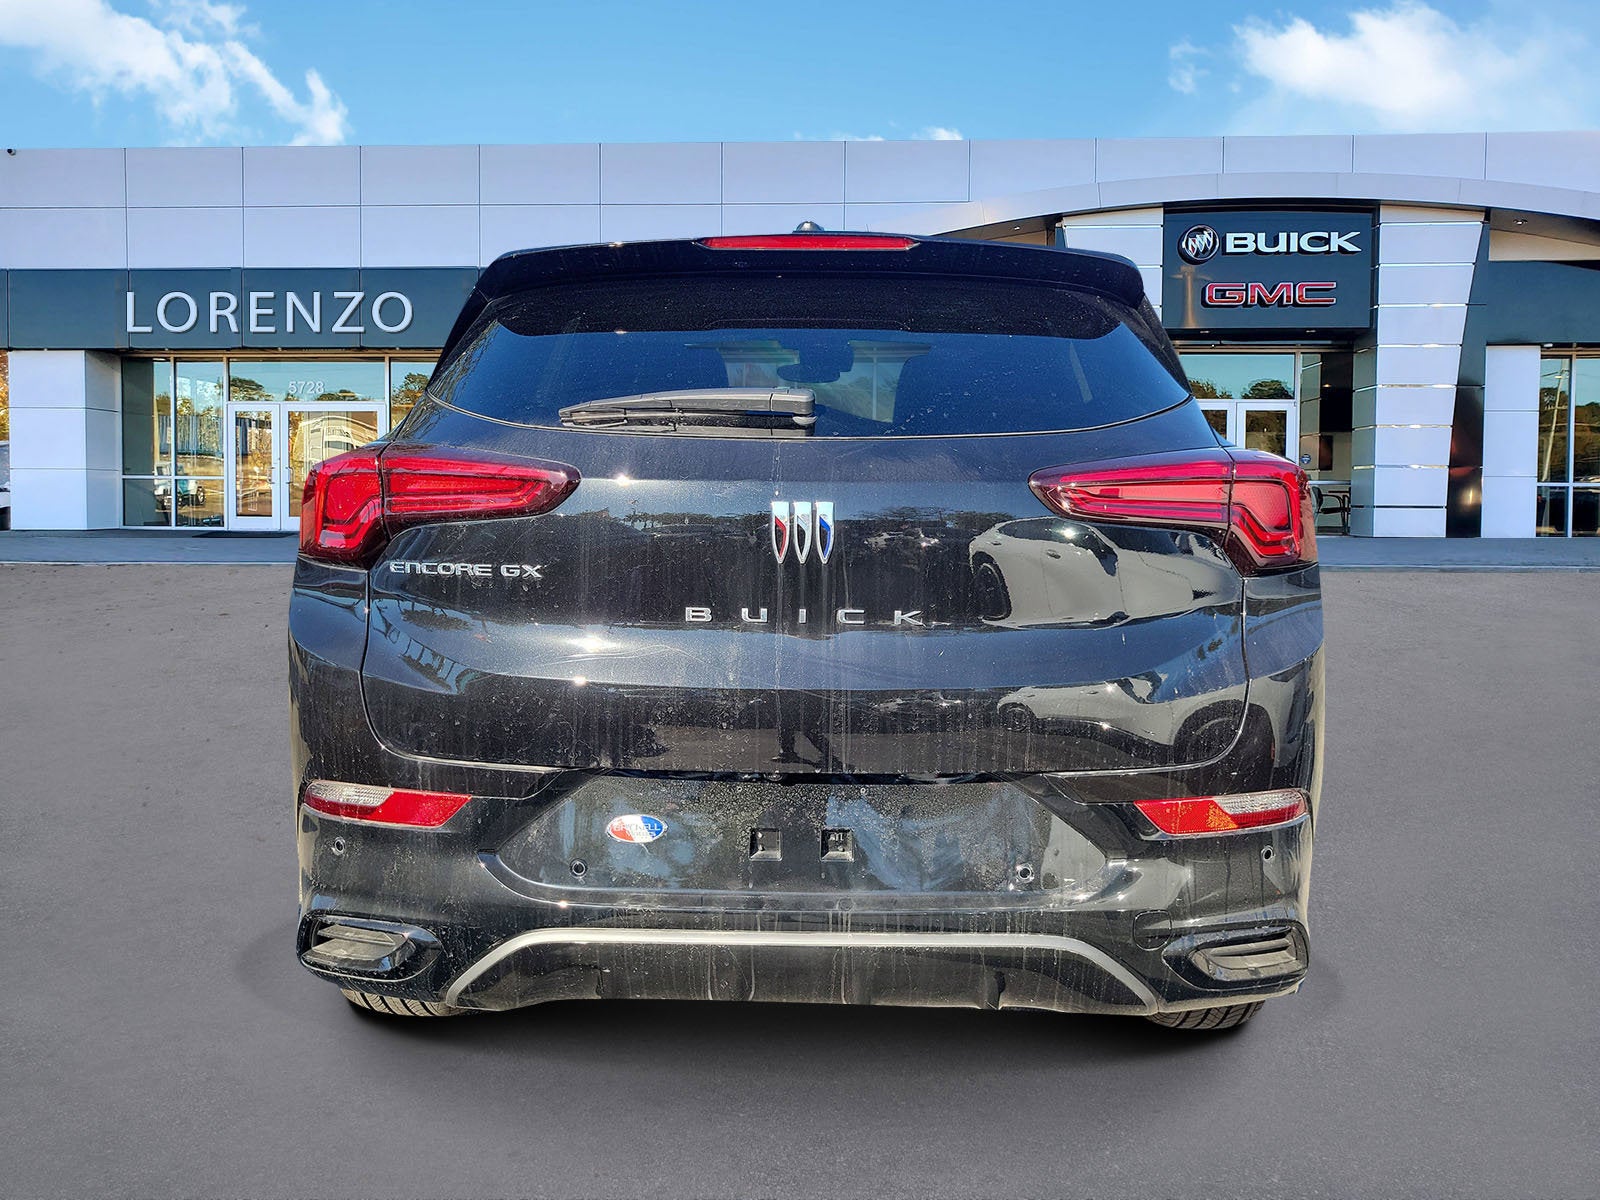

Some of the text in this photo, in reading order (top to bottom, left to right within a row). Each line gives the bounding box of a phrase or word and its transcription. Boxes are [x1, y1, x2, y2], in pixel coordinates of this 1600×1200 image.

[1225, 231, 1362, 253] BUICK
[1206, 281, 1337, 305] GMC
[126, 291, 414, 333] LORENZO
[288, 381, 325, 394] 5728
[389, 561, 543, 578] ENCORE GX
[685, 606, 927, 626] BUICK
